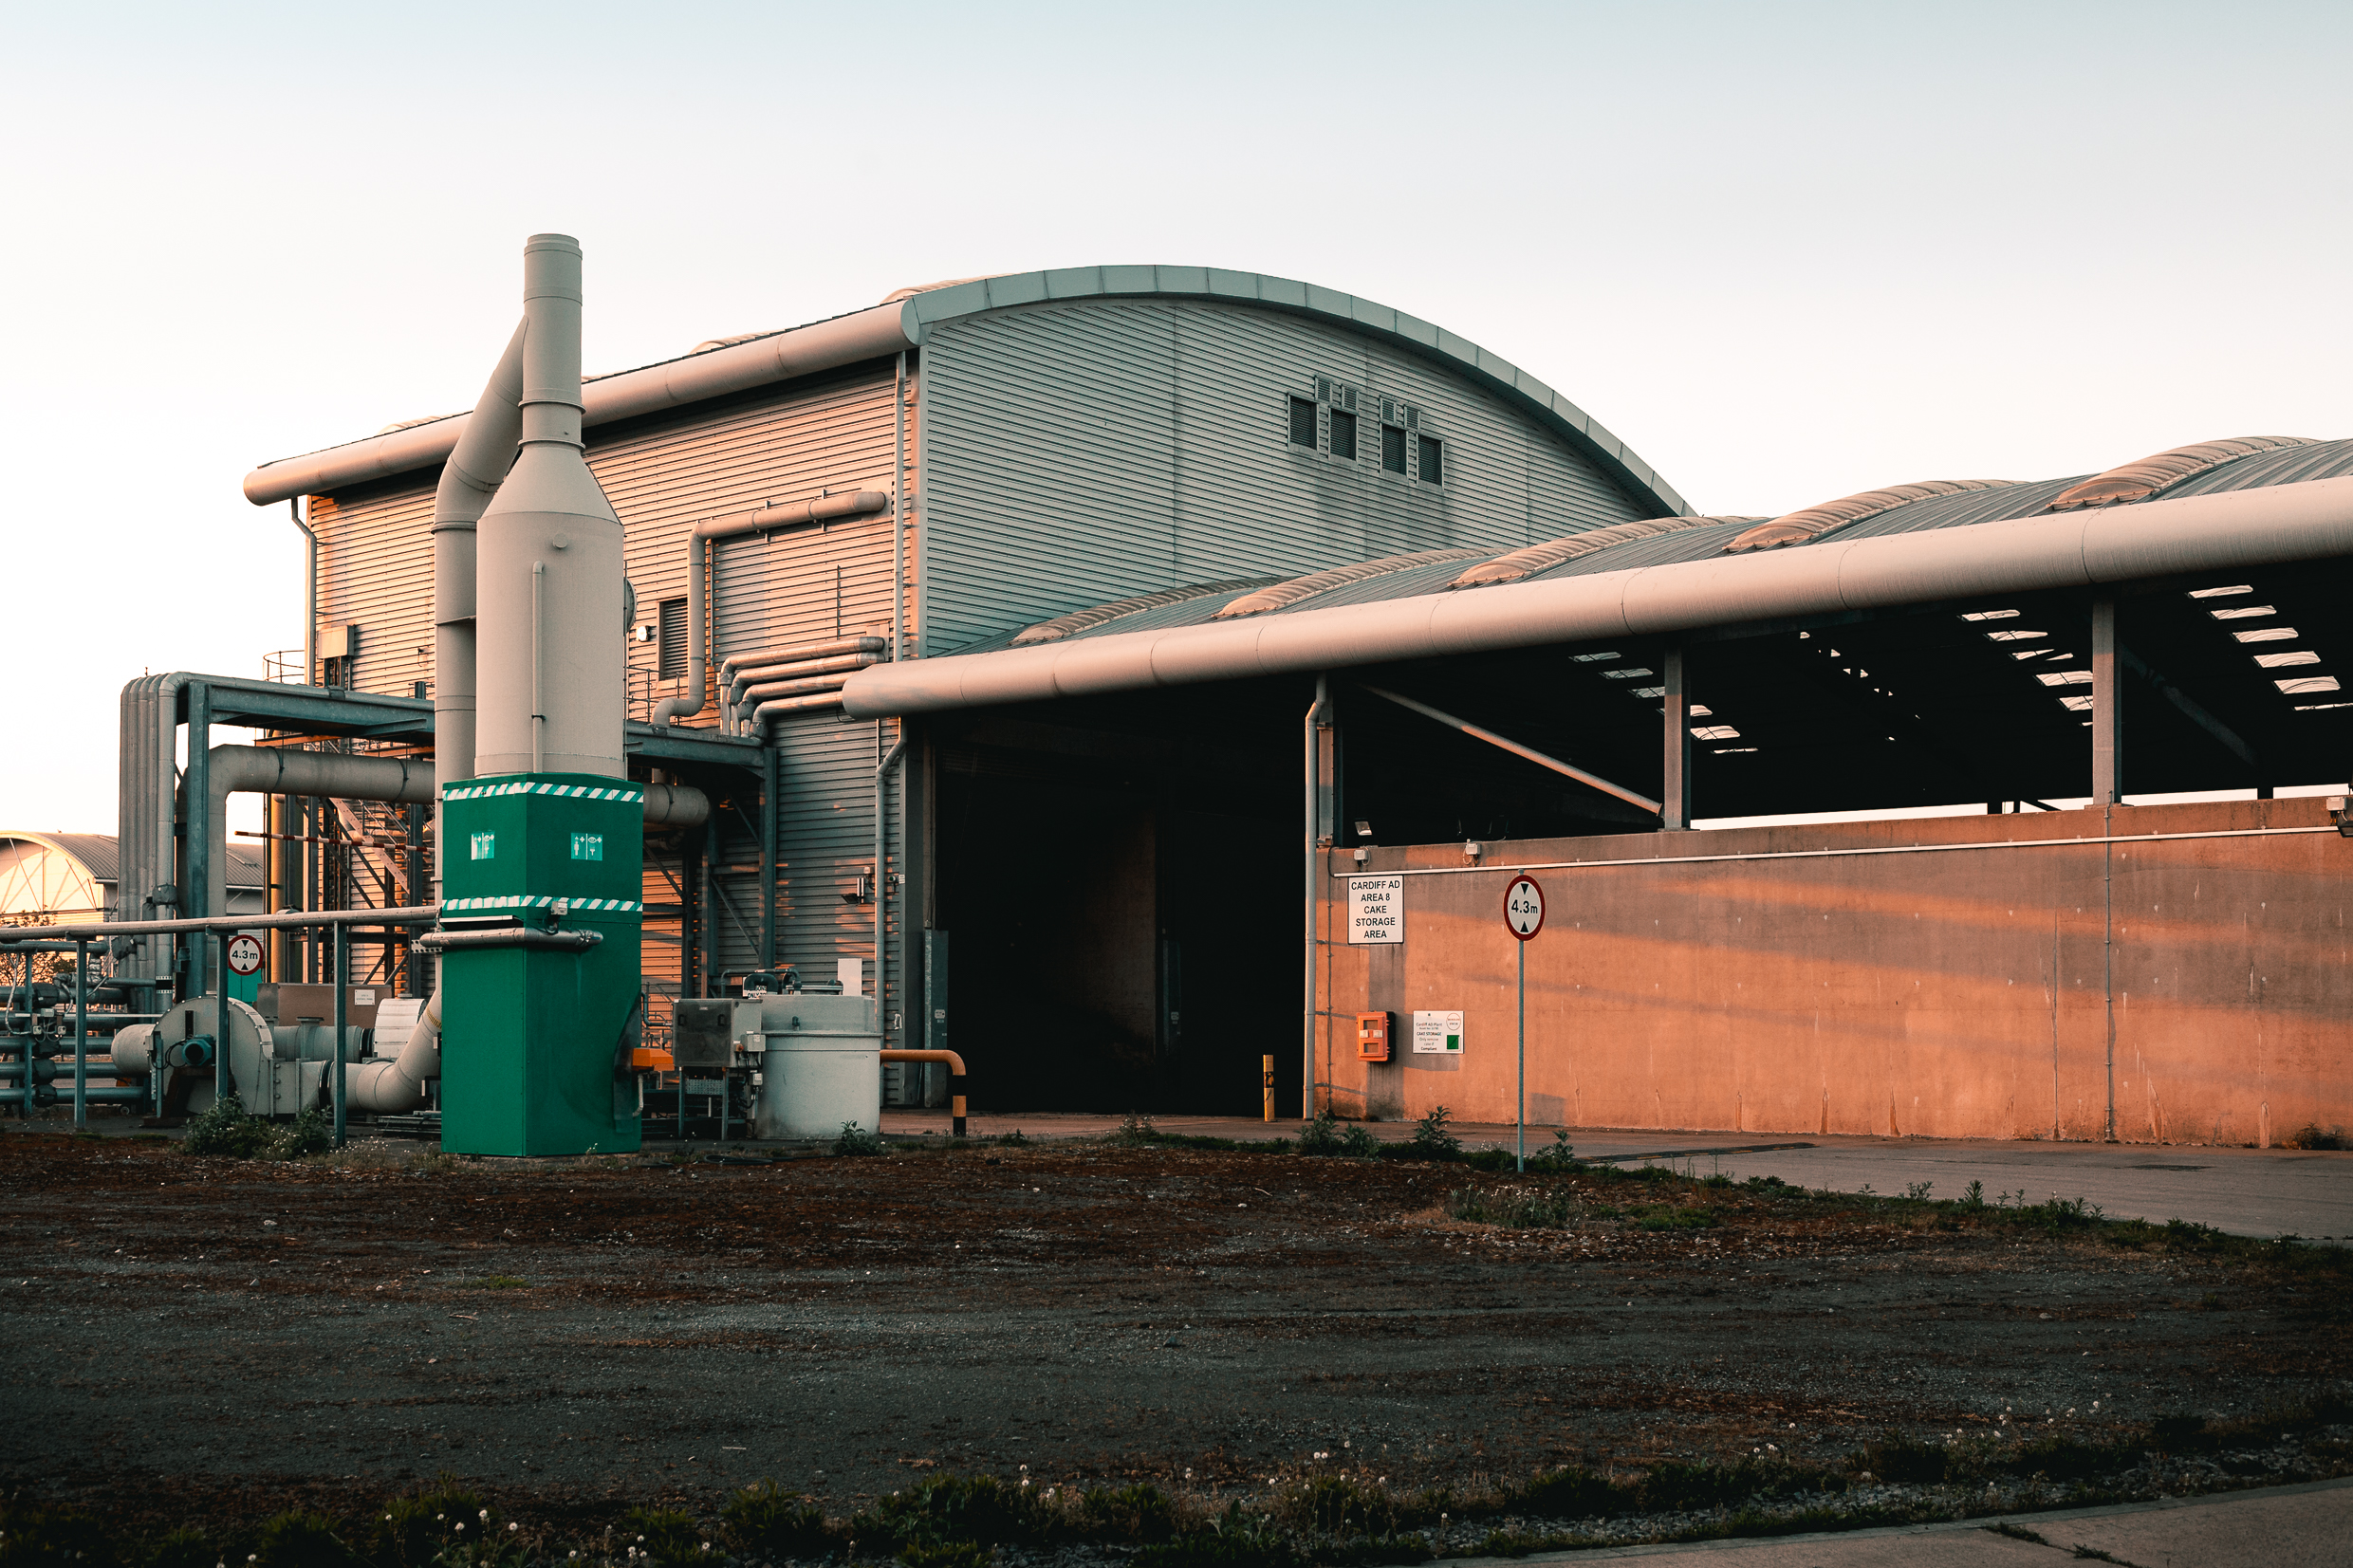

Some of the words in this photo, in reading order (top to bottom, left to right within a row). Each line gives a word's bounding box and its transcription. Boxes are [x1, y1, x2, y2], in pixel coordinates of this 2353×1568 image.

[1351, 881, 1386, 890] CARDIFF
[1388, 880, 1400, 889] AD
[1361, 893, 1384, 902] AREA
[1385, 893, 1391, 901] 8
[1363, 905, 1387, 914] CAKE
[1510, 899, 1538, 913] 4.3m
[1356, 917, 1396, 927] STORAGE
[1363, 930, 1387, 938] AREA
[232, 950, 258, 959] 4.3m
